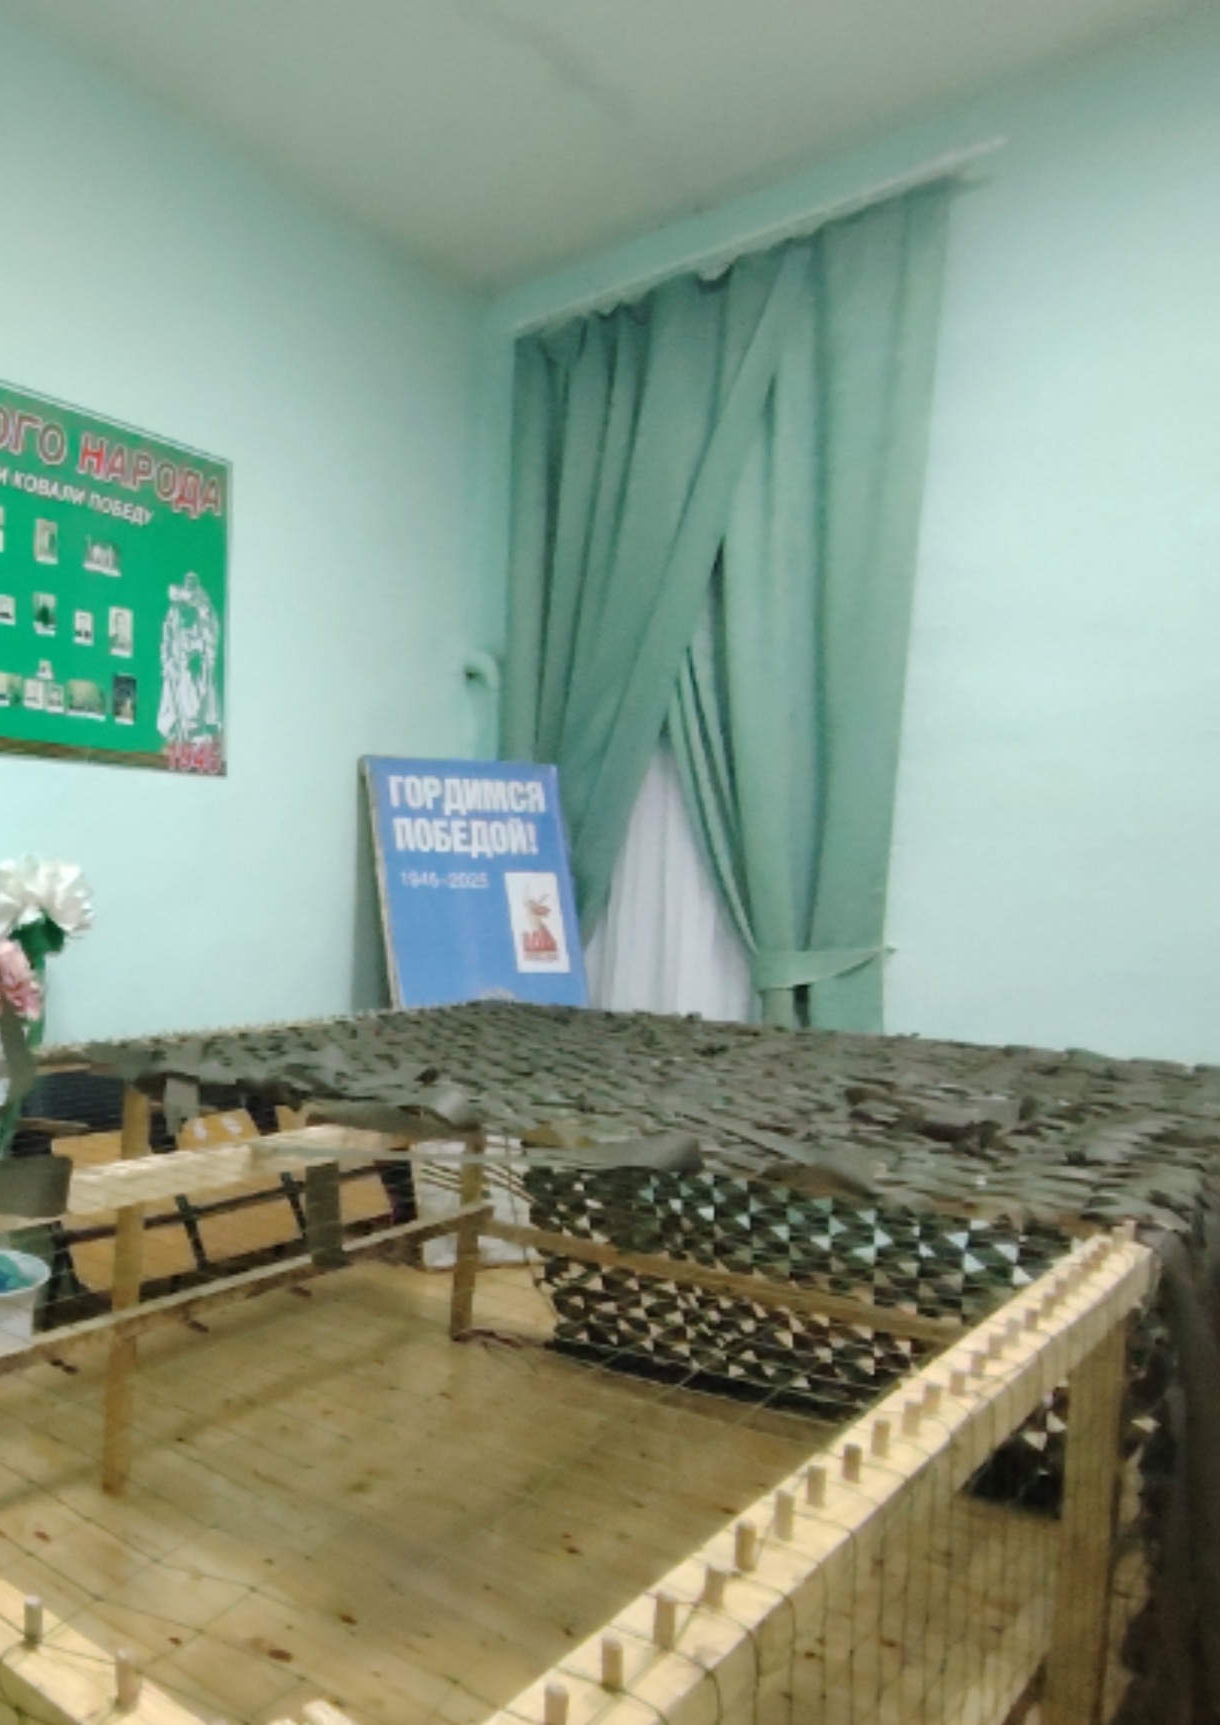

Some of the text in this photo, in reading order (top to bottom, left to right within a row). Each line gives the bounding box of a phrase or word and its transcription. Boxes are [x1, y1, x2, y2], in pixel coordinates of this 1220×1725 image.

[12, 471, 86, 505] КОВАЛИ
[88, 492, 155, 526] ПОБЕДУ
[77, 432, 223, 519] НАРОДА
[388, 775, 547, 816] ГОРДИМСЯ
[393, 817, 540, 858] ПОБЕДОЙ!
